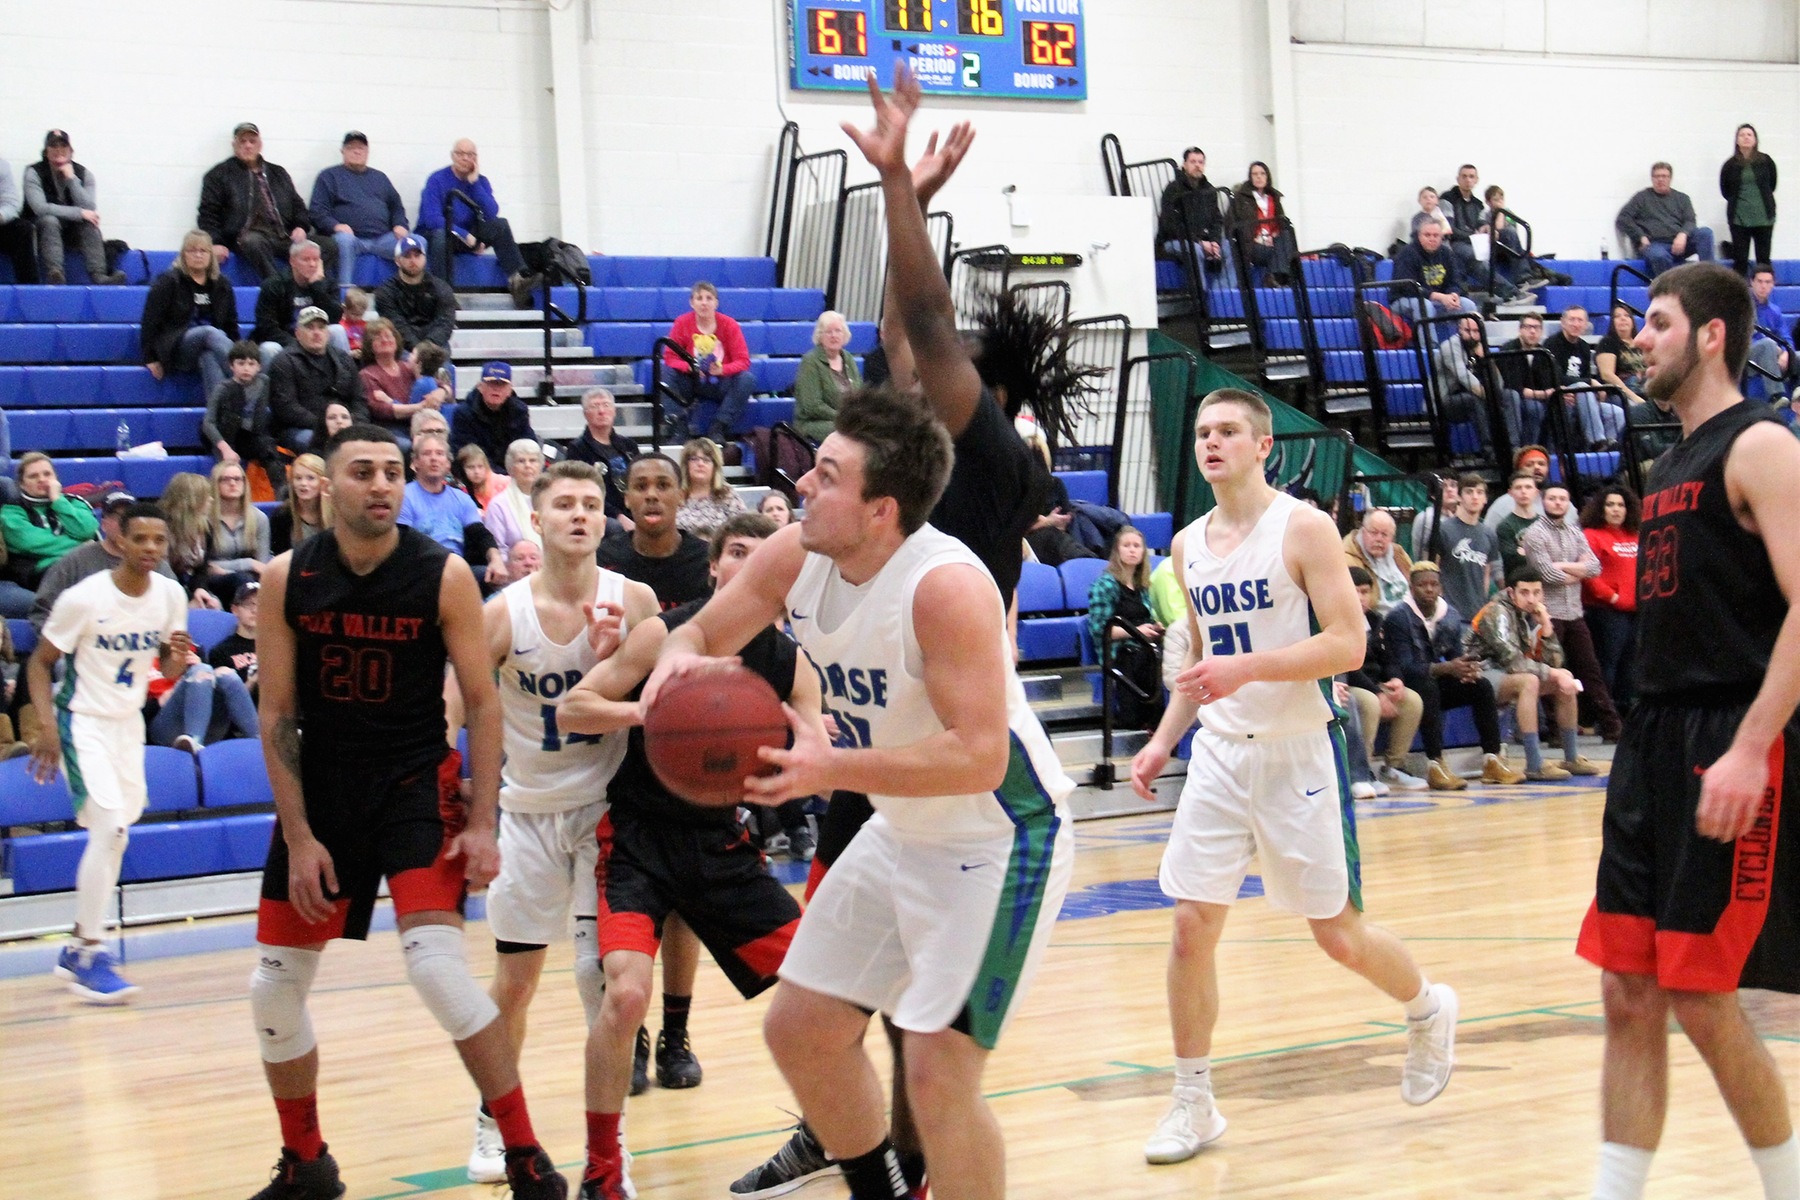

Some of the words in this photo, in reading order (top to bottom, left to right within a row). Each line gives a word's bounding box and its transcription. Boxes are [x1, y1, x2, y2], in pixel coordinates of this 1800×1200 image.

[1014, 0, 1079, 15] VISITOR
[816, 9, 867, 56] 61
[1030, 21, 1076, 66] 62
[918, 42, 945, 57] POSS
[833, 63, 877, 82] BONUS
[908, 56, 957, 75] PERIOD
[961, 52, 981, 88] 2
[1013, 71, 1055, 89] BONUS
[1189, 578, 1274, 617] NORSE
[342, 612, 423, 641] VALLEY
[114, 657, 134, 688] 4
[319, 643, 392, 703] 20
[516, 669, 583, 699] NOR
[806, 650, 888, 709] RSE
[541, 704, 604, 752] 1
